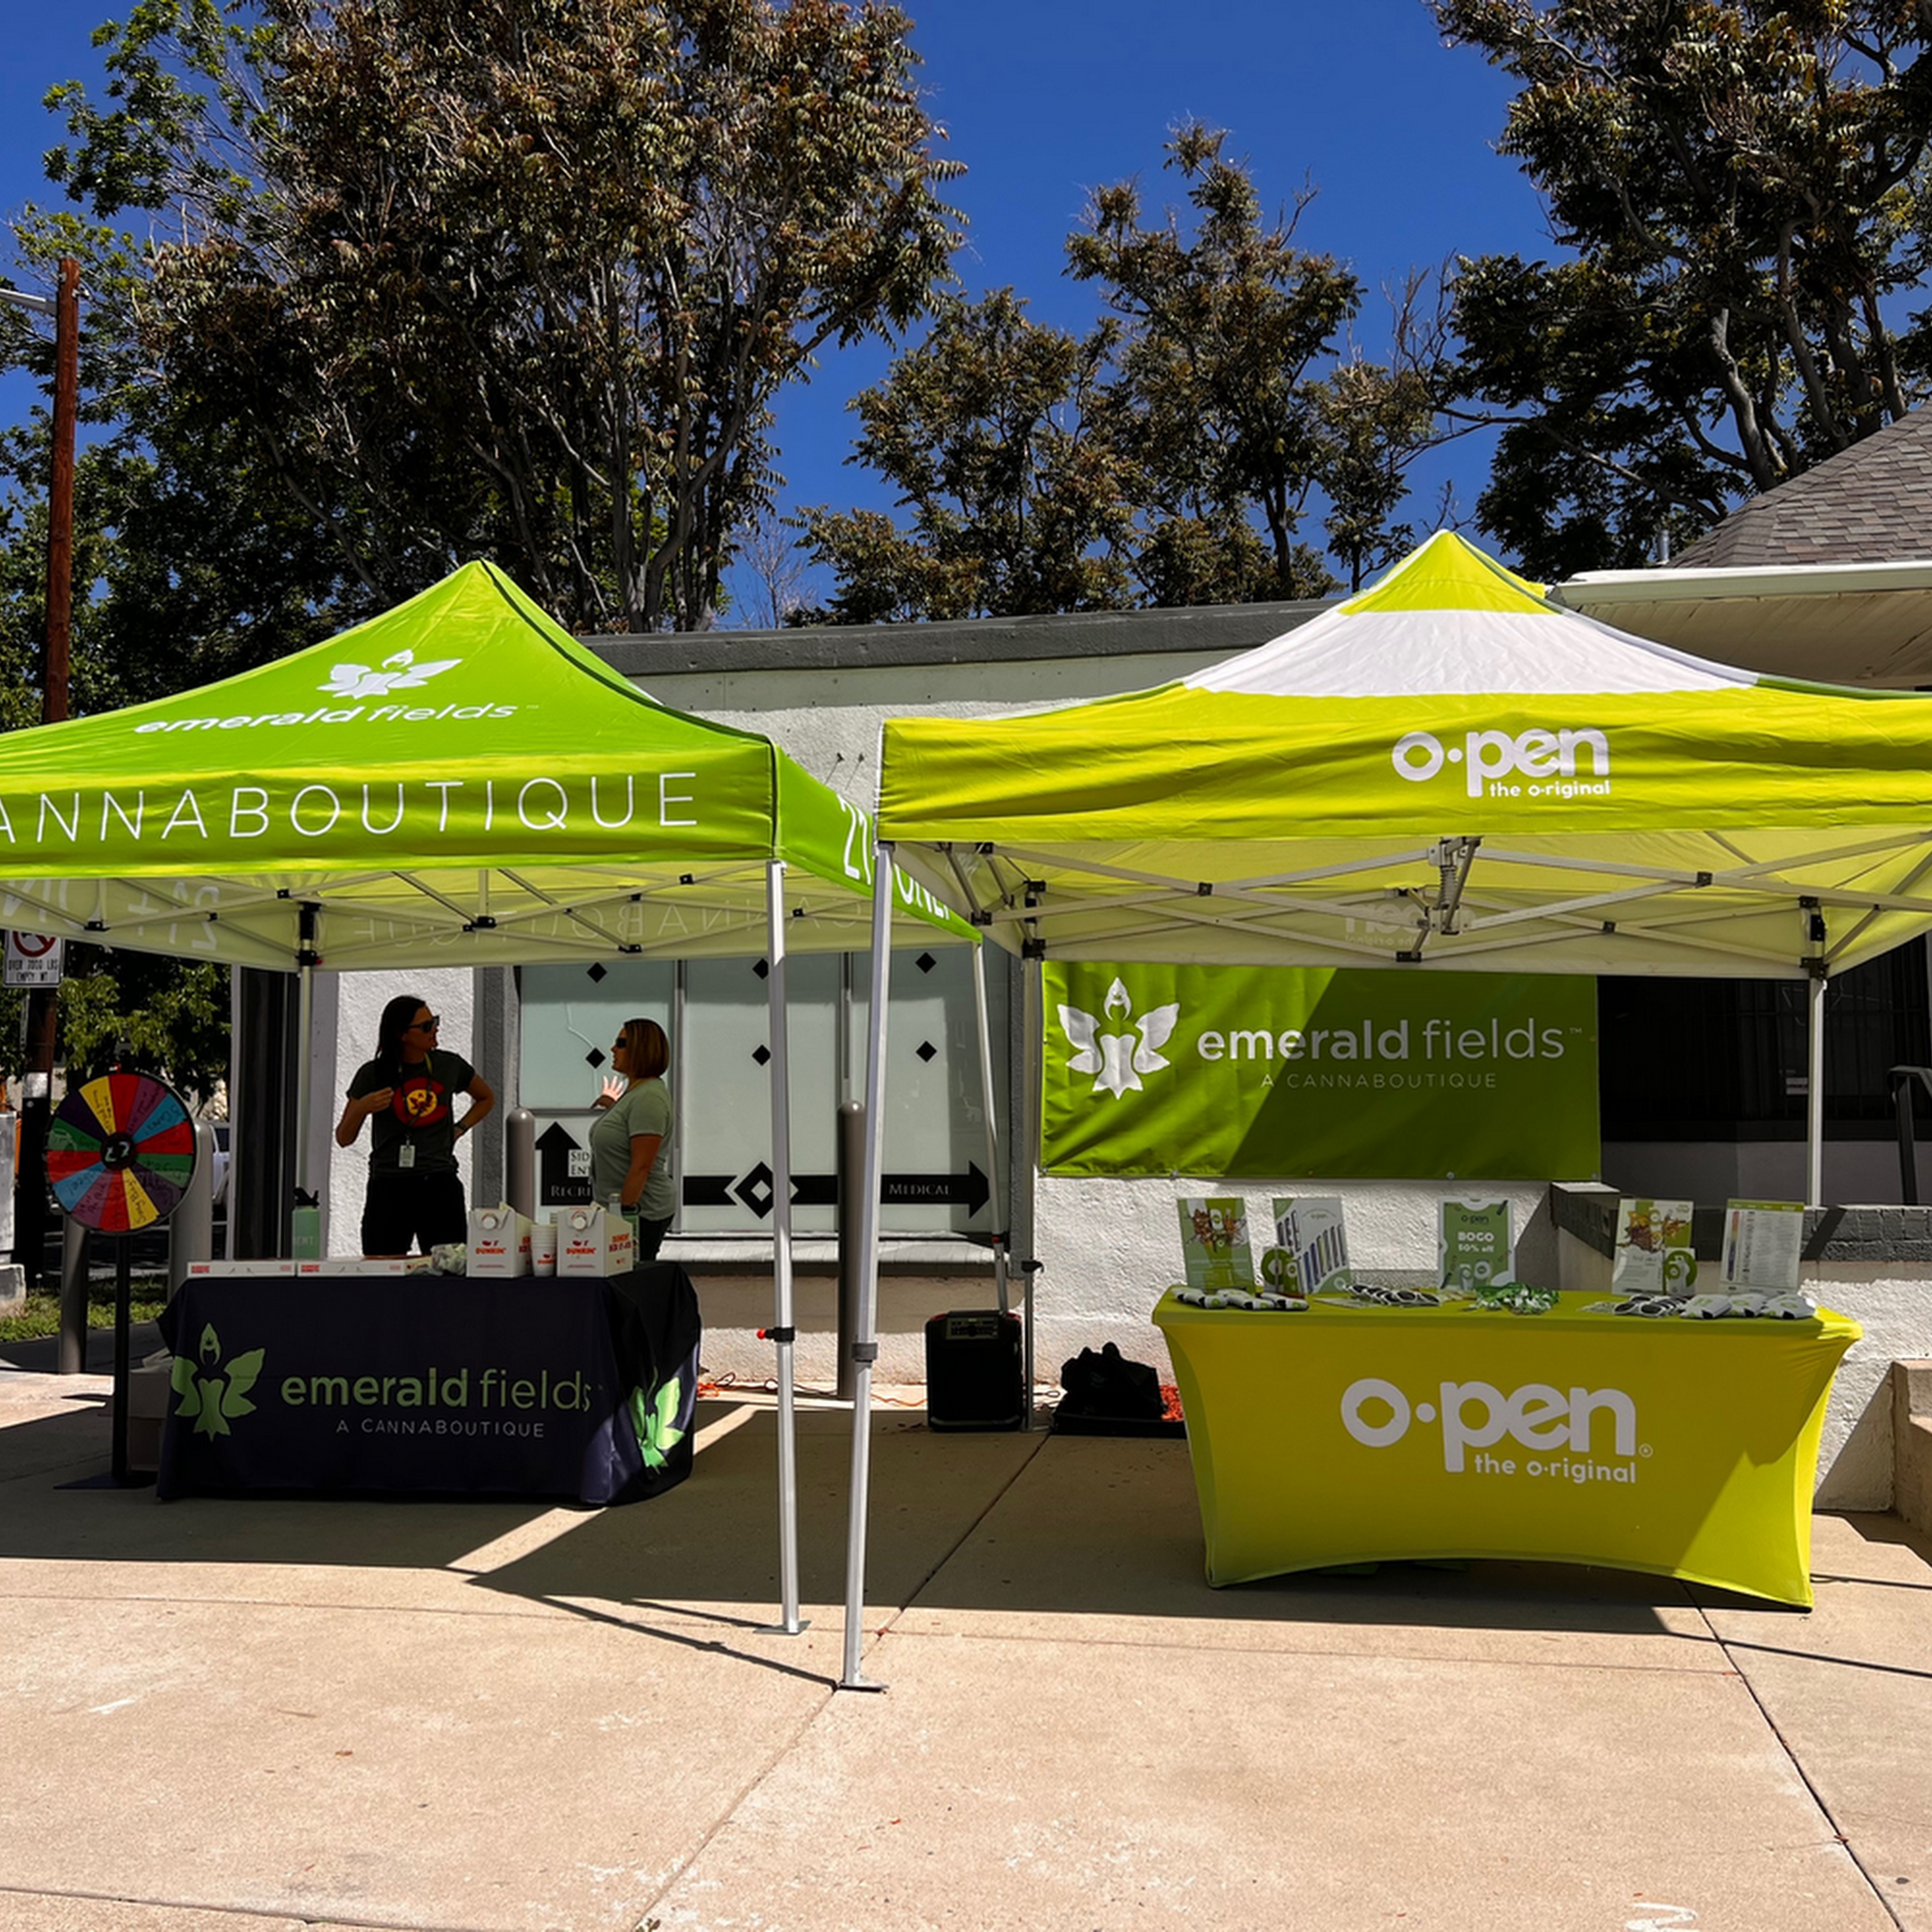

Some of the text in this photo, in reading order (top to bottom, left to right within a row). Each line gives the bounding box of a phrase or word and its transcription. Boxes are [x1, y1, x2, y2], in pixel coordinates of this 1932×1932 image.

[134, 702, 518, 734] emerald fields
[1489, 781, 1521, 797] the
[1197, 1017, 1565, 1061] emerald fields
[1260, 1072, 1497, 1089] A CANNABOUTIQUE
[570, 1151, 591, 1162] SID
[570, 1165, 592, 1176] EN
[889, 1183, 952, 1196] MEDICAL
[280, 1366, 469, 1408] emerald
[336, 1418, 545, 1438] A CANNABOUTIQUE
[1474, 1453, 1517, 1475] the
